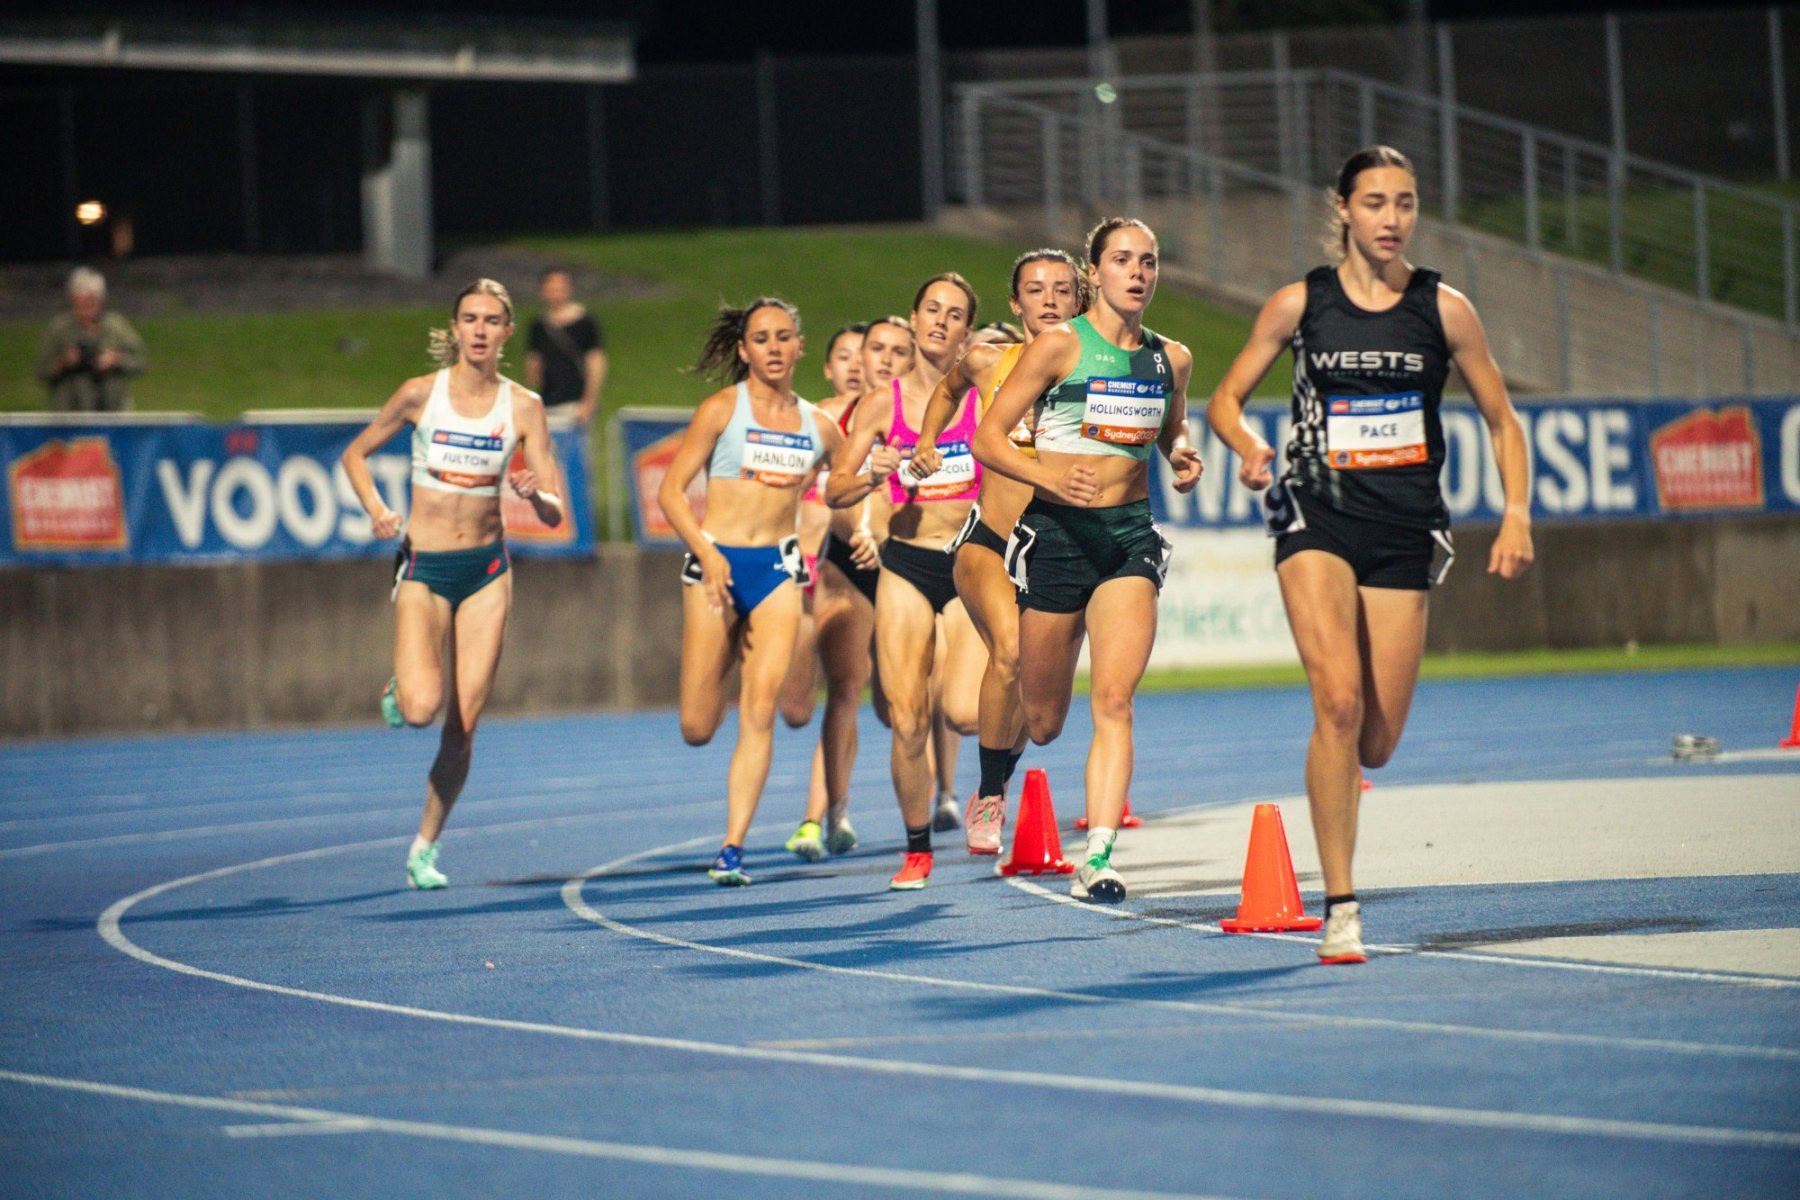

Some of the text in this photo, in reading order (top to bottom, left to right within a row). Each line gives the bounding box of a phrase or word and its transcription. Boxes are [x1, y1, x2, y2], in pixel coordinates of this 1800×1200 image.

[1311, 351, 1424, 372] WESTS
[1107, 381, 1137, 391] CHEMIST
[1089, 403, 1162, 417] HOLLINGSWORTH
[1360, 423, 1397, 437] PACE
[442, 451, 489, 466] FULTON
[753, 451, 805, 468] HANLON
